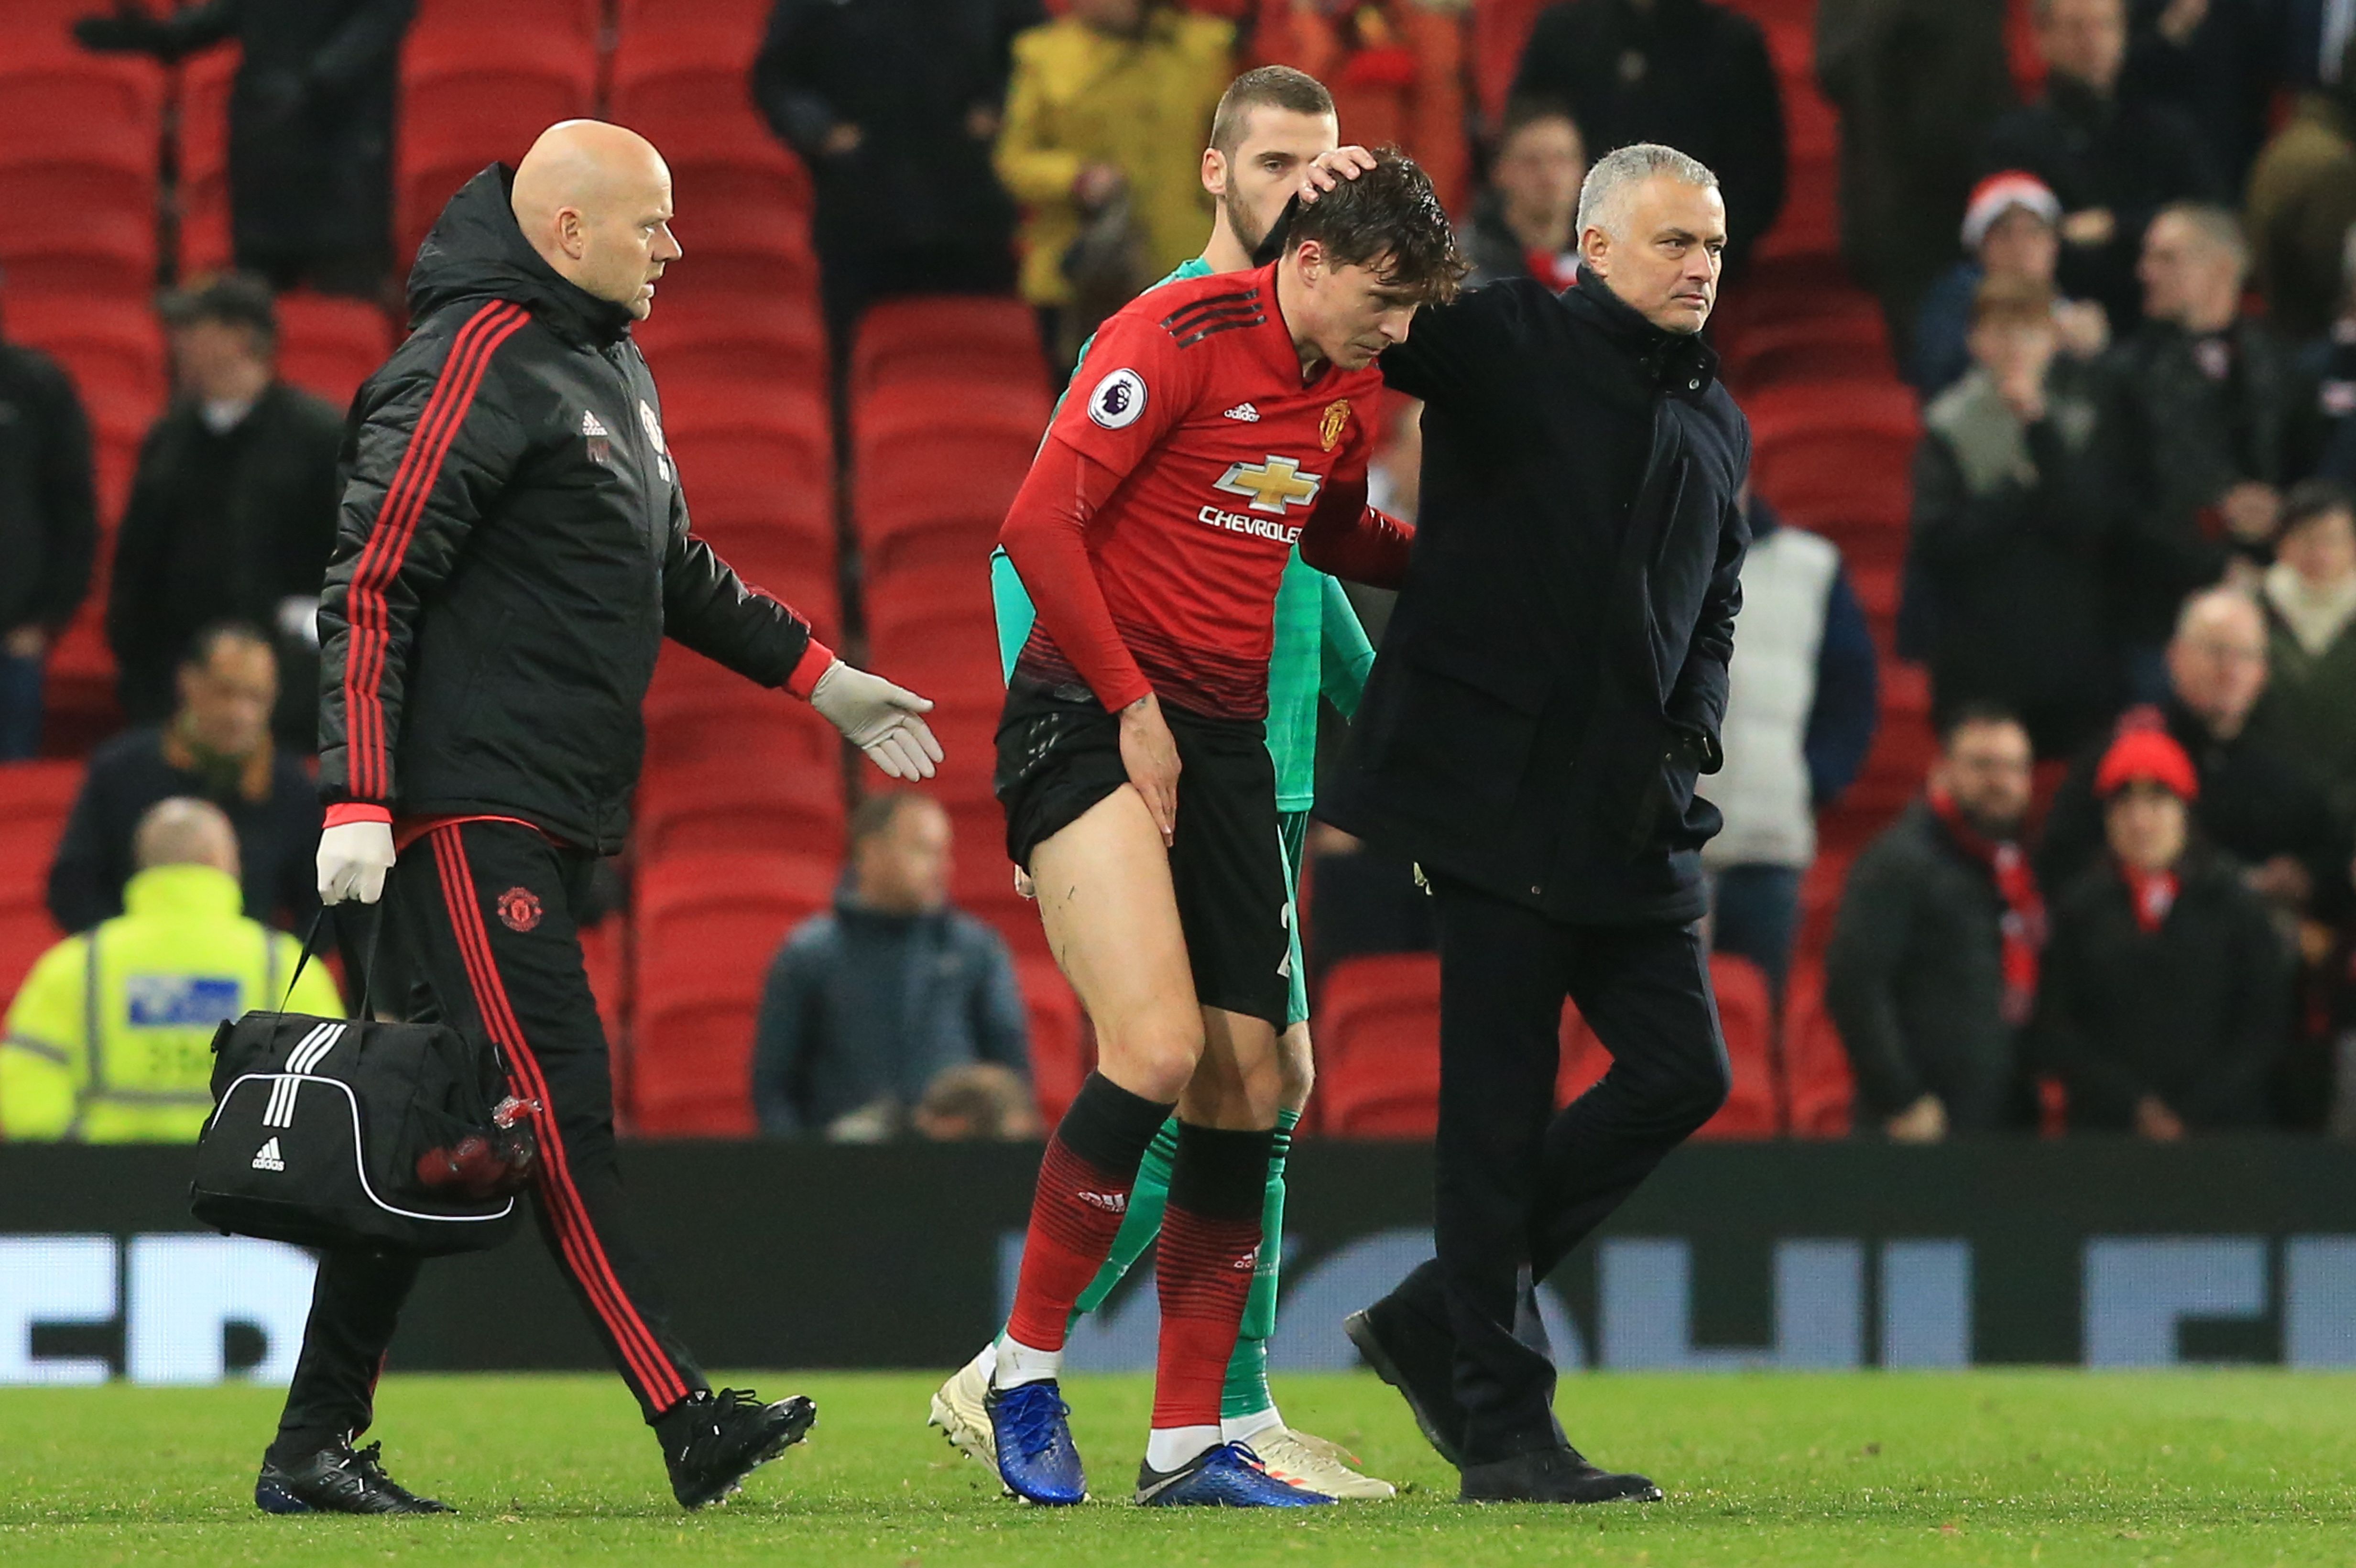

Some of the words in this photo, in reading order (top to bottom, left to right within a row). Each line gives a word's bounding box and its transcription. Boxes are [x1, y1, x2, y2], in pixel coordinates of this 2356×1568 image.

[1224, 409, 1260, 422] adidas
[1199, 505, 1303, 544] CHEVROLE
[252, 1157, 284, 1171] adidas
